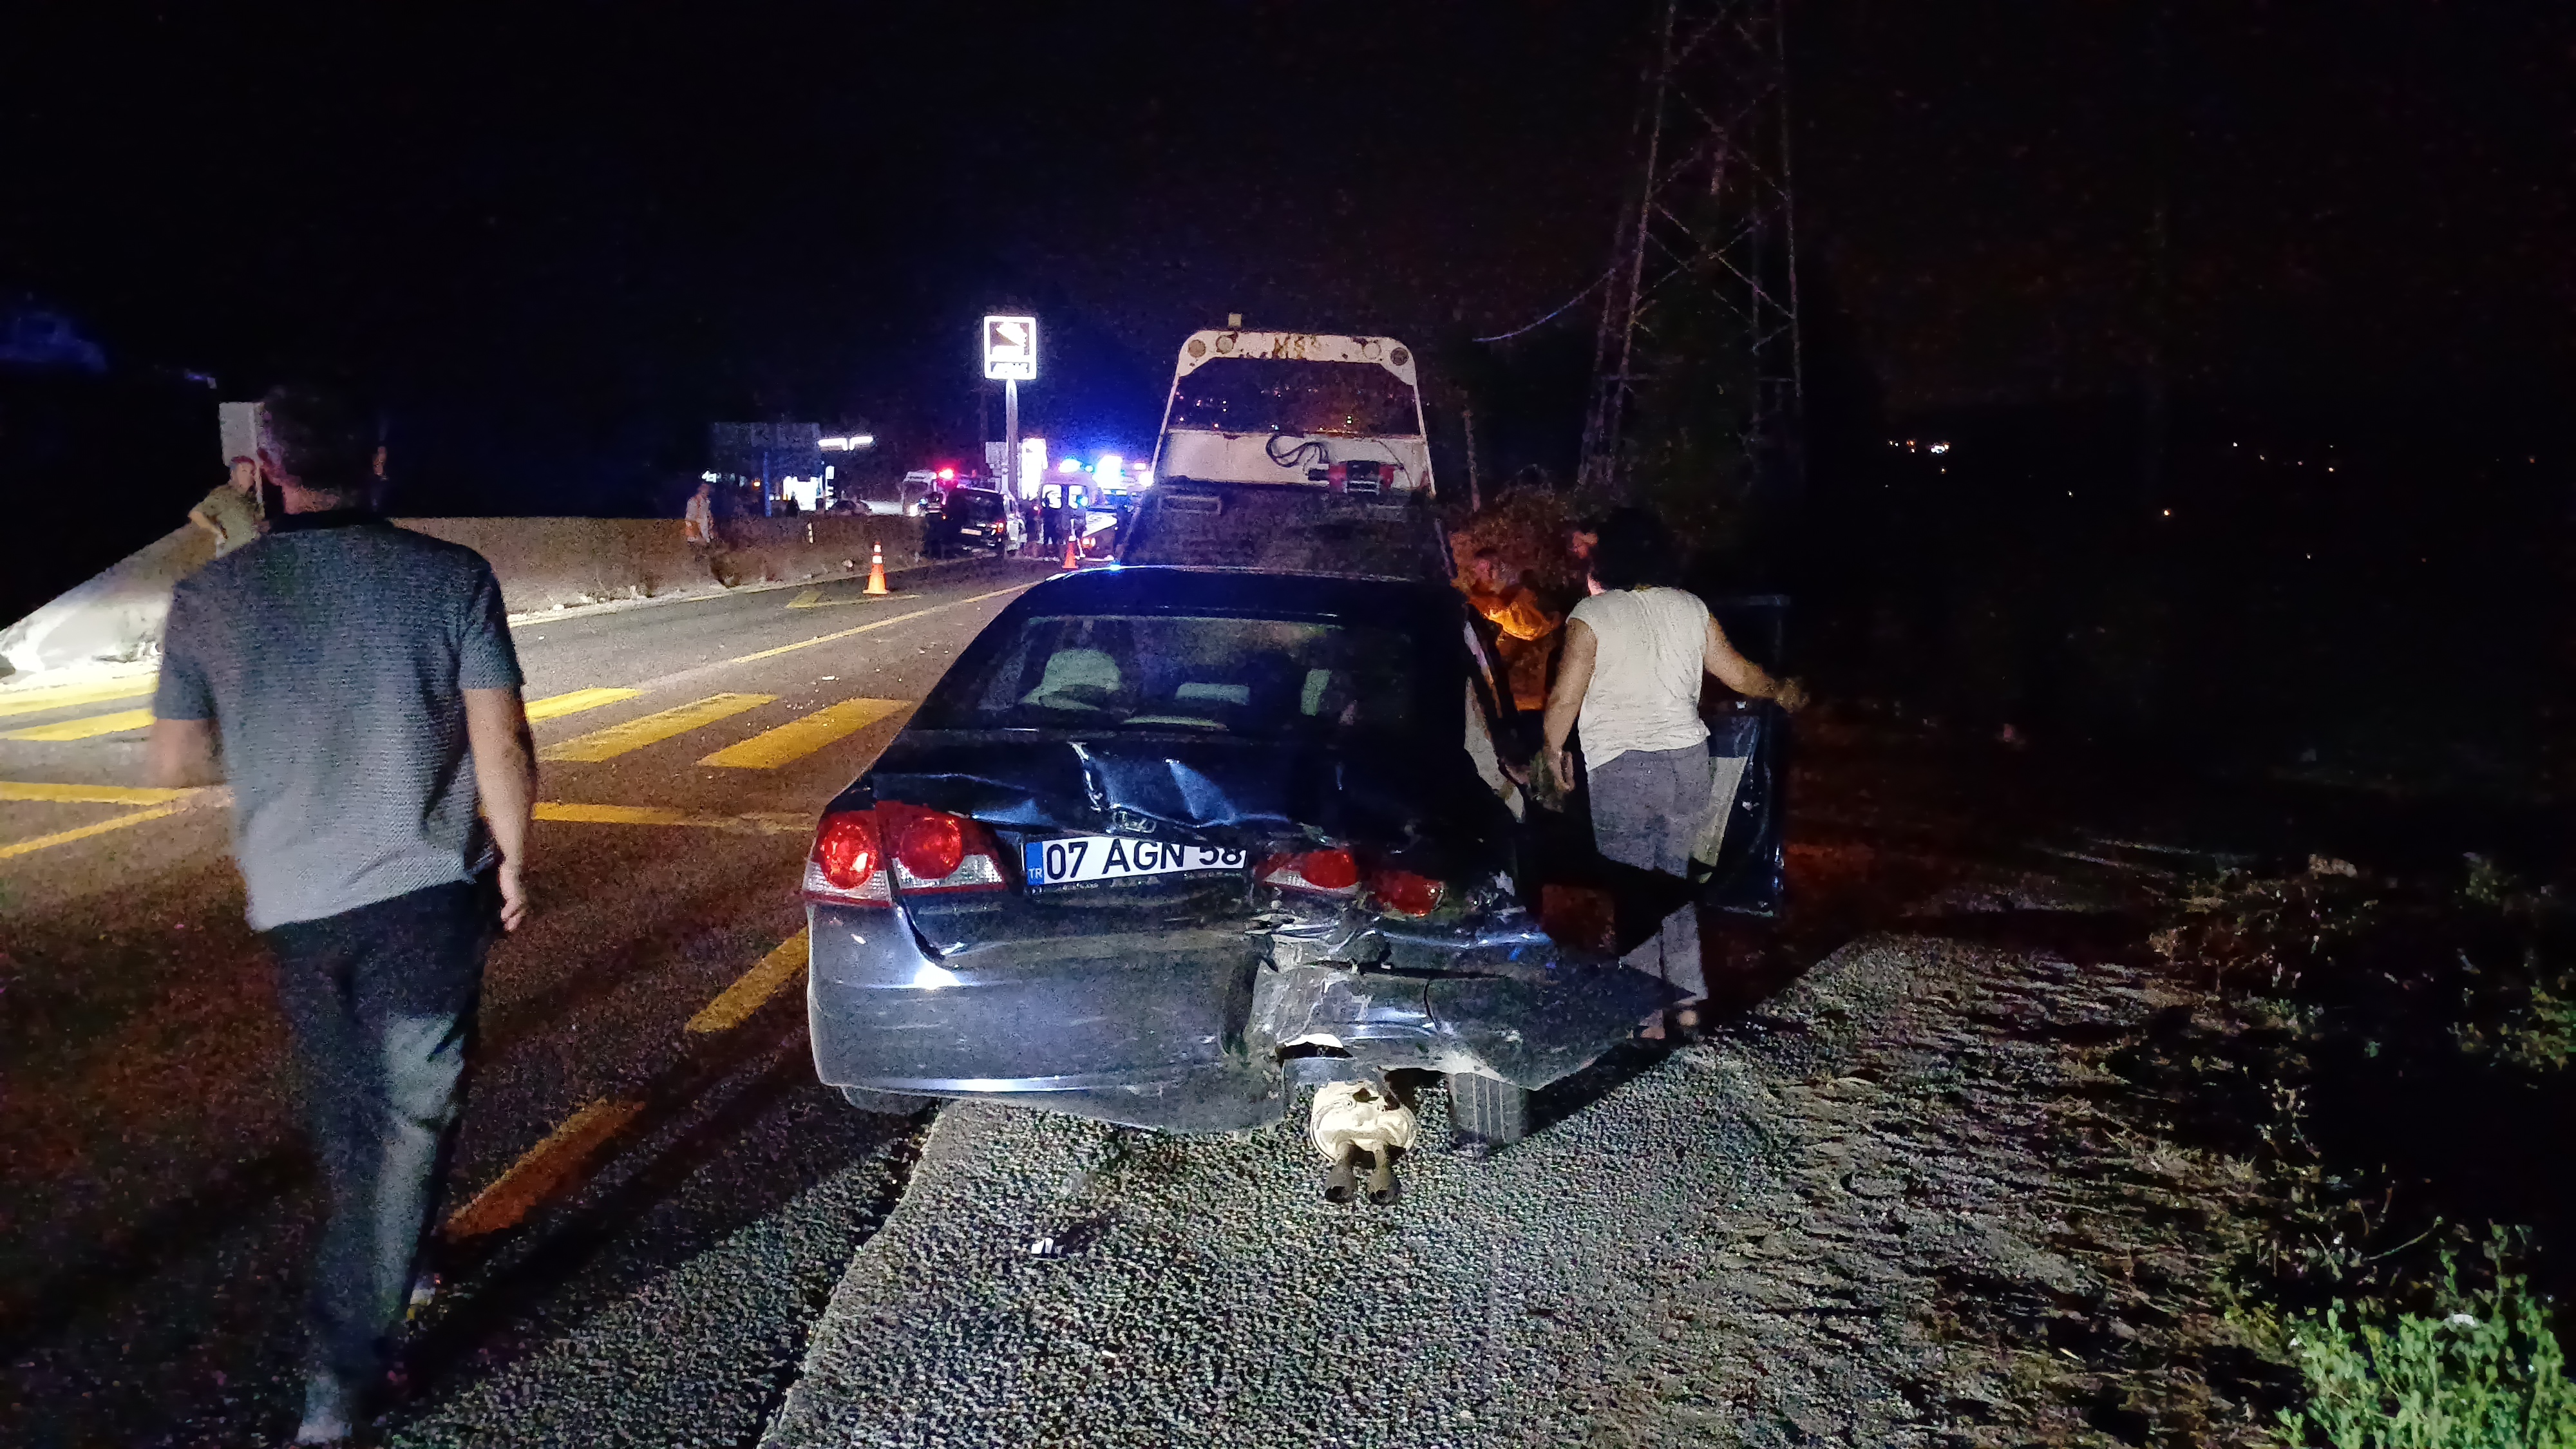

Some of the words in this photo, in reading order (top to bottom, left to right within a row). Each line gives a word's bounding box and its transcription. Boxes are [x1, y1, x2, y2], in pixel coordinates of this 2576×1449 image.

[1046, 841, 1088, 880] 07
[1102, 838, 1184, 874] AGN
[1028, 867, 1043, 880] TR
